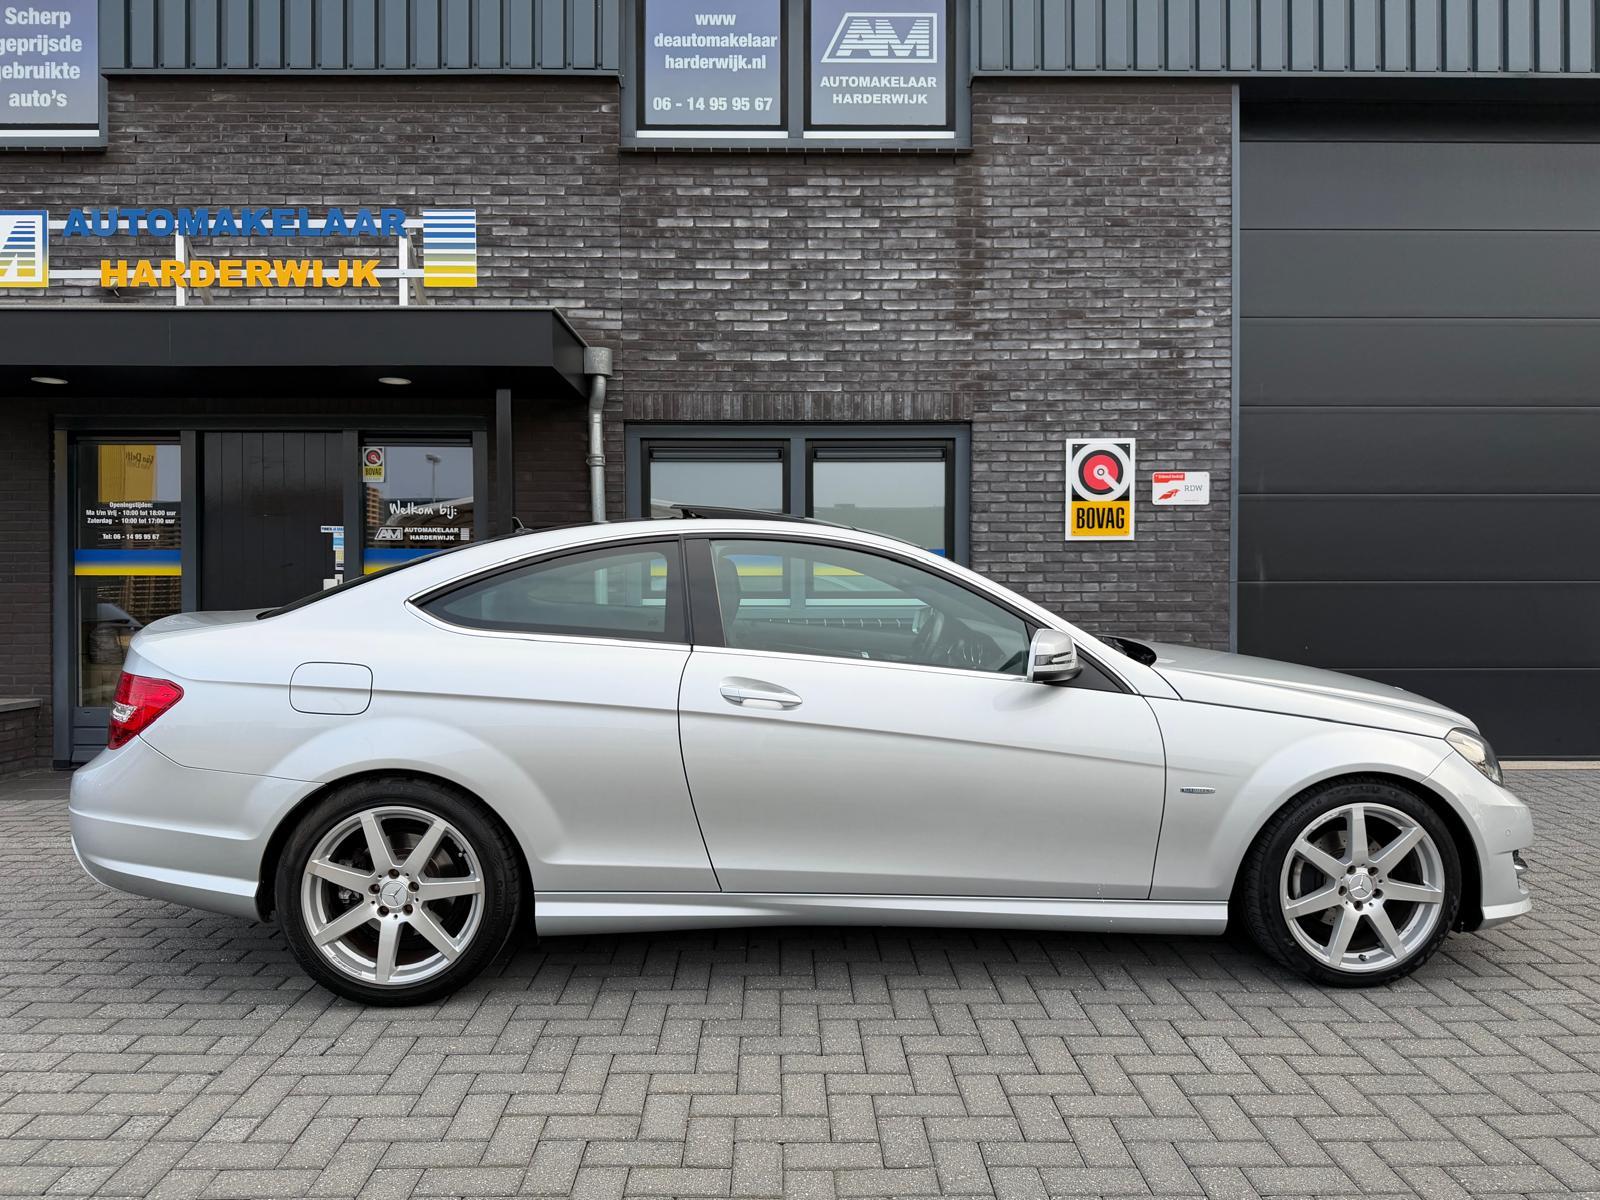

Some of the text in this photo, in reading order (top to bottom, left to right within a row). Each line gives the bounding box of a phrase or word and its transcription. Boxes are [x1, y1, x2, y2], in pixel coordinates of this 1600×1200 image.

[5, 7, 71, 29] Scherp
[695, 14, 737, 26] www
[654, 33, 778, 48] deautomakelaar
[664, 55, 767, 72] harderwijk.nl
[0, 62, 81, 83] ebruikte
[820, 76, 937, 88] AUTOMAKELAAR
[9, 90, 68, 107] auto's
[653, 97, 672, 110] 06
[687, 97, 705, 110] 14
[709, 97, 728, 110] 95
[732, 97, 751, 110] 95
[755, 97, 773, 110] 67
[832, 93, 928, 105] HARDERWIJK
[62, 208, 408, 238] AUTOMAKELAAR
[100, 259, 381, 288] HARDERWIJK
[365, 467, 382, 476] BOVAG
[389, 499, 458, 519] Welkom bij:
[1076, 507, 1125, 529] BOVAG
